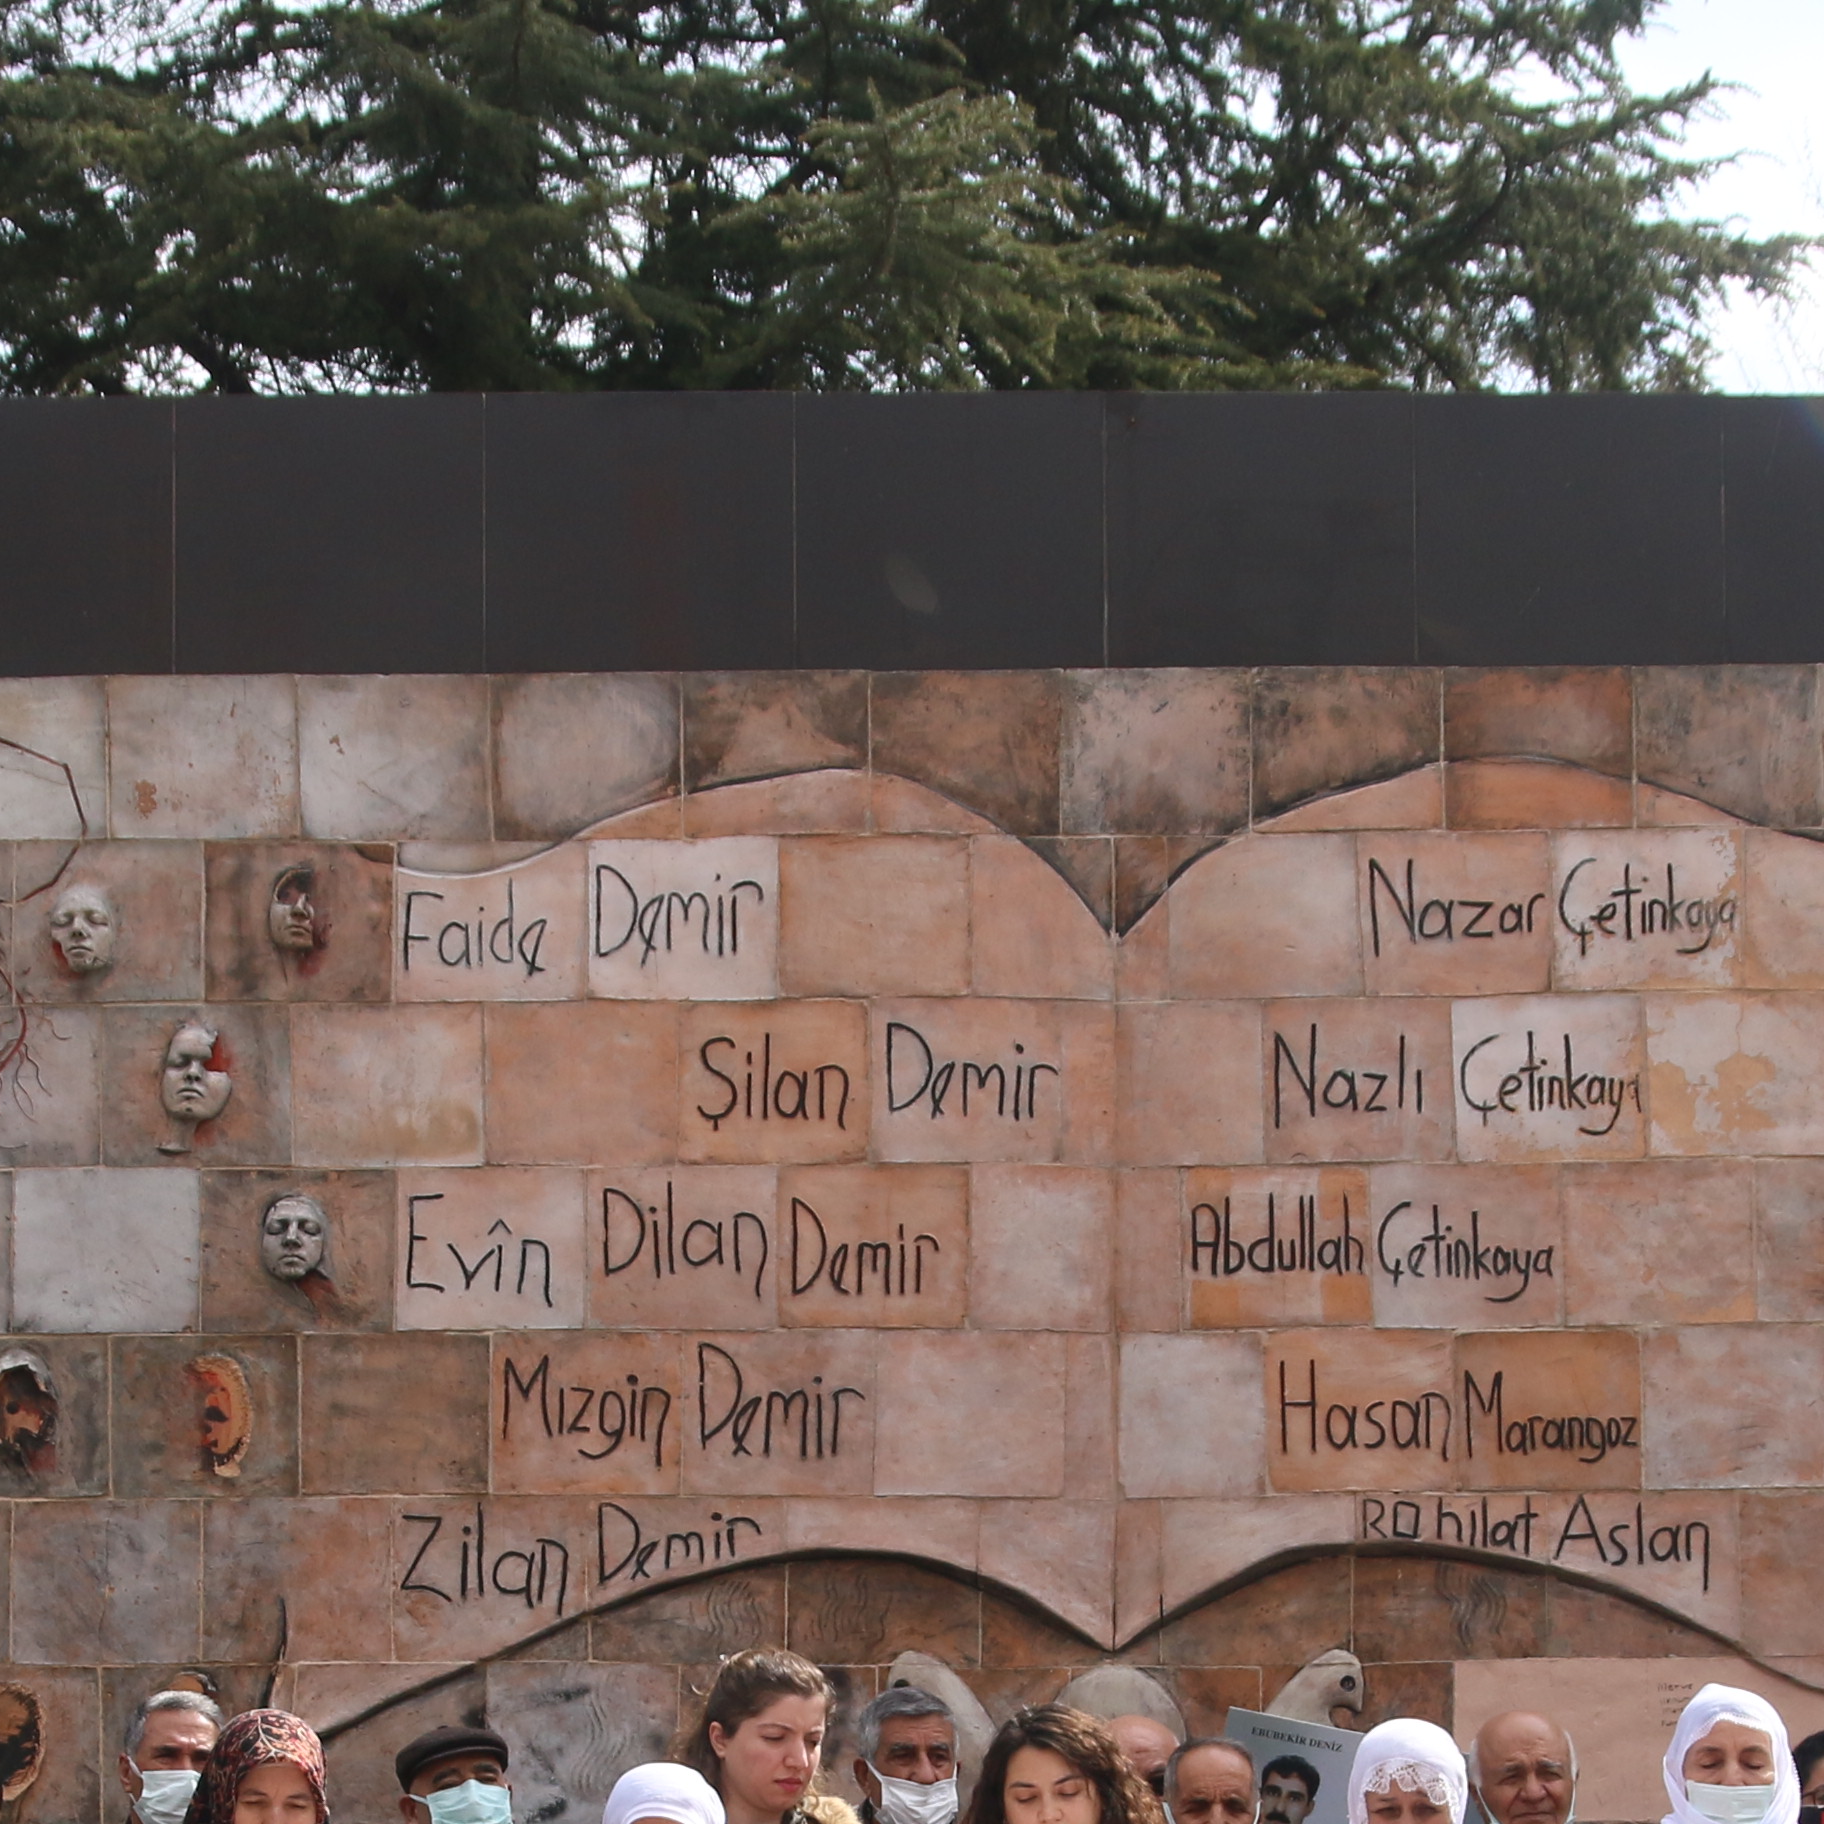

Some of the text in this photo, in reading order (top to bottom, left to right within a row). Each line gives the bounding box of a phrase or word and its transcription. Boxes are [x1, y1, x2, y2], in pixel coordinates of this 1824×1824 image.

[403, 864, 763, 977] Faide Demir
[1368, 857, 1738, 957] Nazar Çetinkaya
[697, 1021, 1058, 1132] Şilan Demir
[1272, 1022, 1424, 1129] Nazlı
[602, 1180, 767, 1298] Dilan
[790, 1197, 940, 1296] Demir
[1189, 1192, 1555, 1303] Abdullah Çetinkaya
[697, 1341, 866, 1459] Demir
[1279, 1359, 1638, 1465] Hasan Marangoz
[401, 1501, 762, 1617] Zilan Demir
[1553, 1493, 1710, 1592] Aslan
[1309, 1738, 1343, 1753] DENİZ
